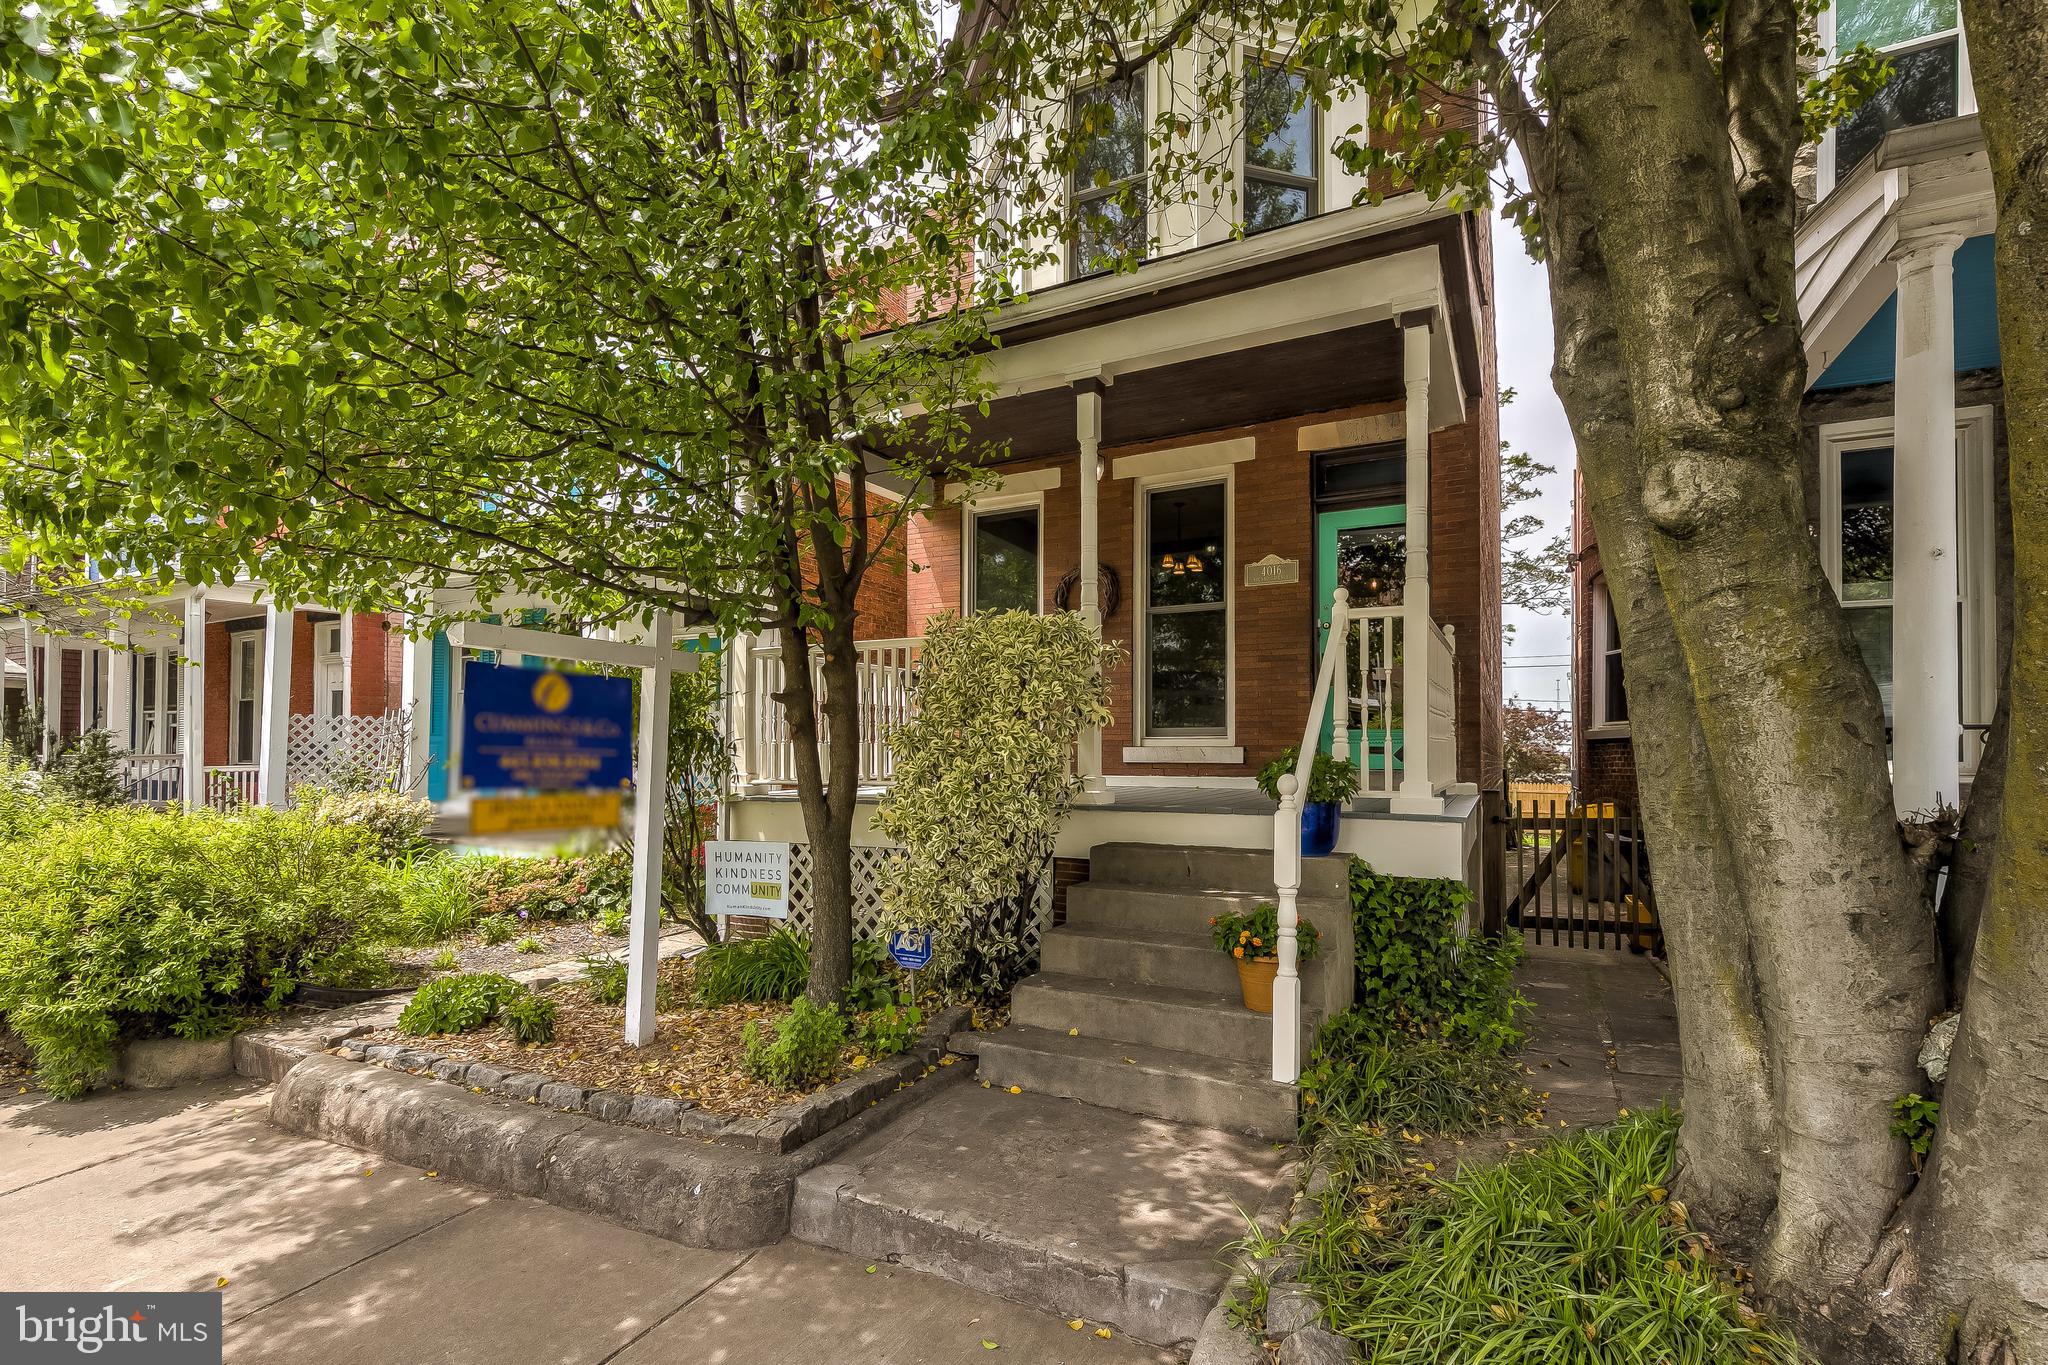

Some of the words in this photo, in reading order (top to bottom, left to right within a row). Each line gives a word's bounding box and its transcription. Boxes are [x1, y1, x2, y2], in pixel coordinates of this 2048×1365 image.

[1261, 565, 1282, 576] 4016
[714, 851, 782, 864] HUMANITY
[715, 867, 782, 880] KINDNESS
[715, 883, 782, 897] COMMUNITY
